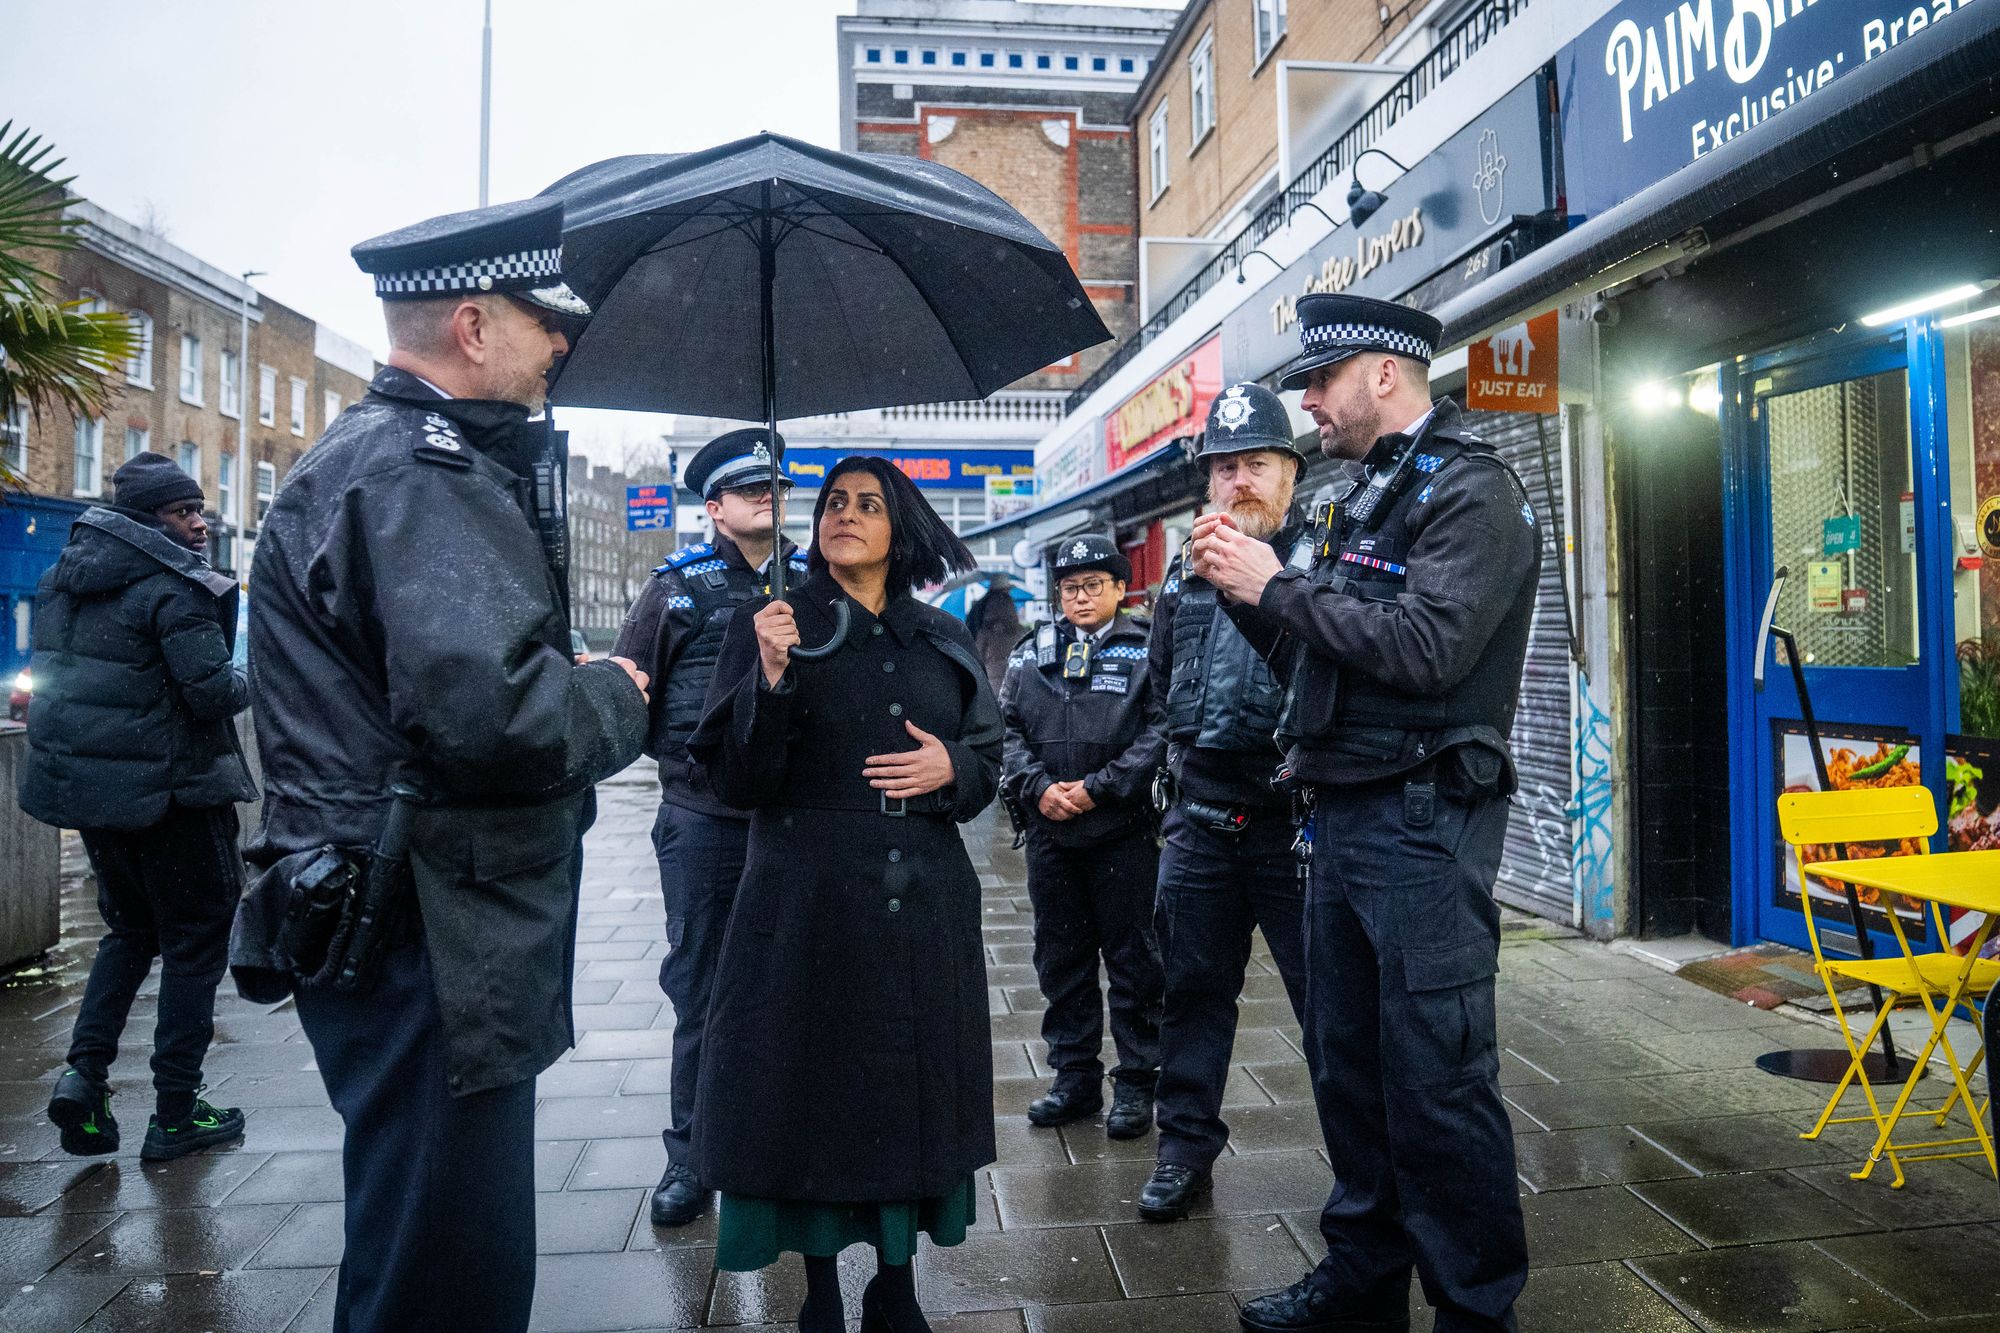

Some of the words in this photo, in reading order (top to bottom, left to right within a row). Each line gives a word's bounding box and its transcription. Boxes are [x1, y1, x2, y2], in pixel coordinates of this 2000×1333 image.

[1863, 0, 1977, 62] Brea
[1605, 0, 1718, 143] PAIM
[1357, 207, 1424, 280] Lovers
[1464, 247, 1491, 281] 268
[1478, 380, 1514, 397] JUST
[1516, 382, 1547, 398] EAT
[1825, 531, 1845, 545] OPEN
